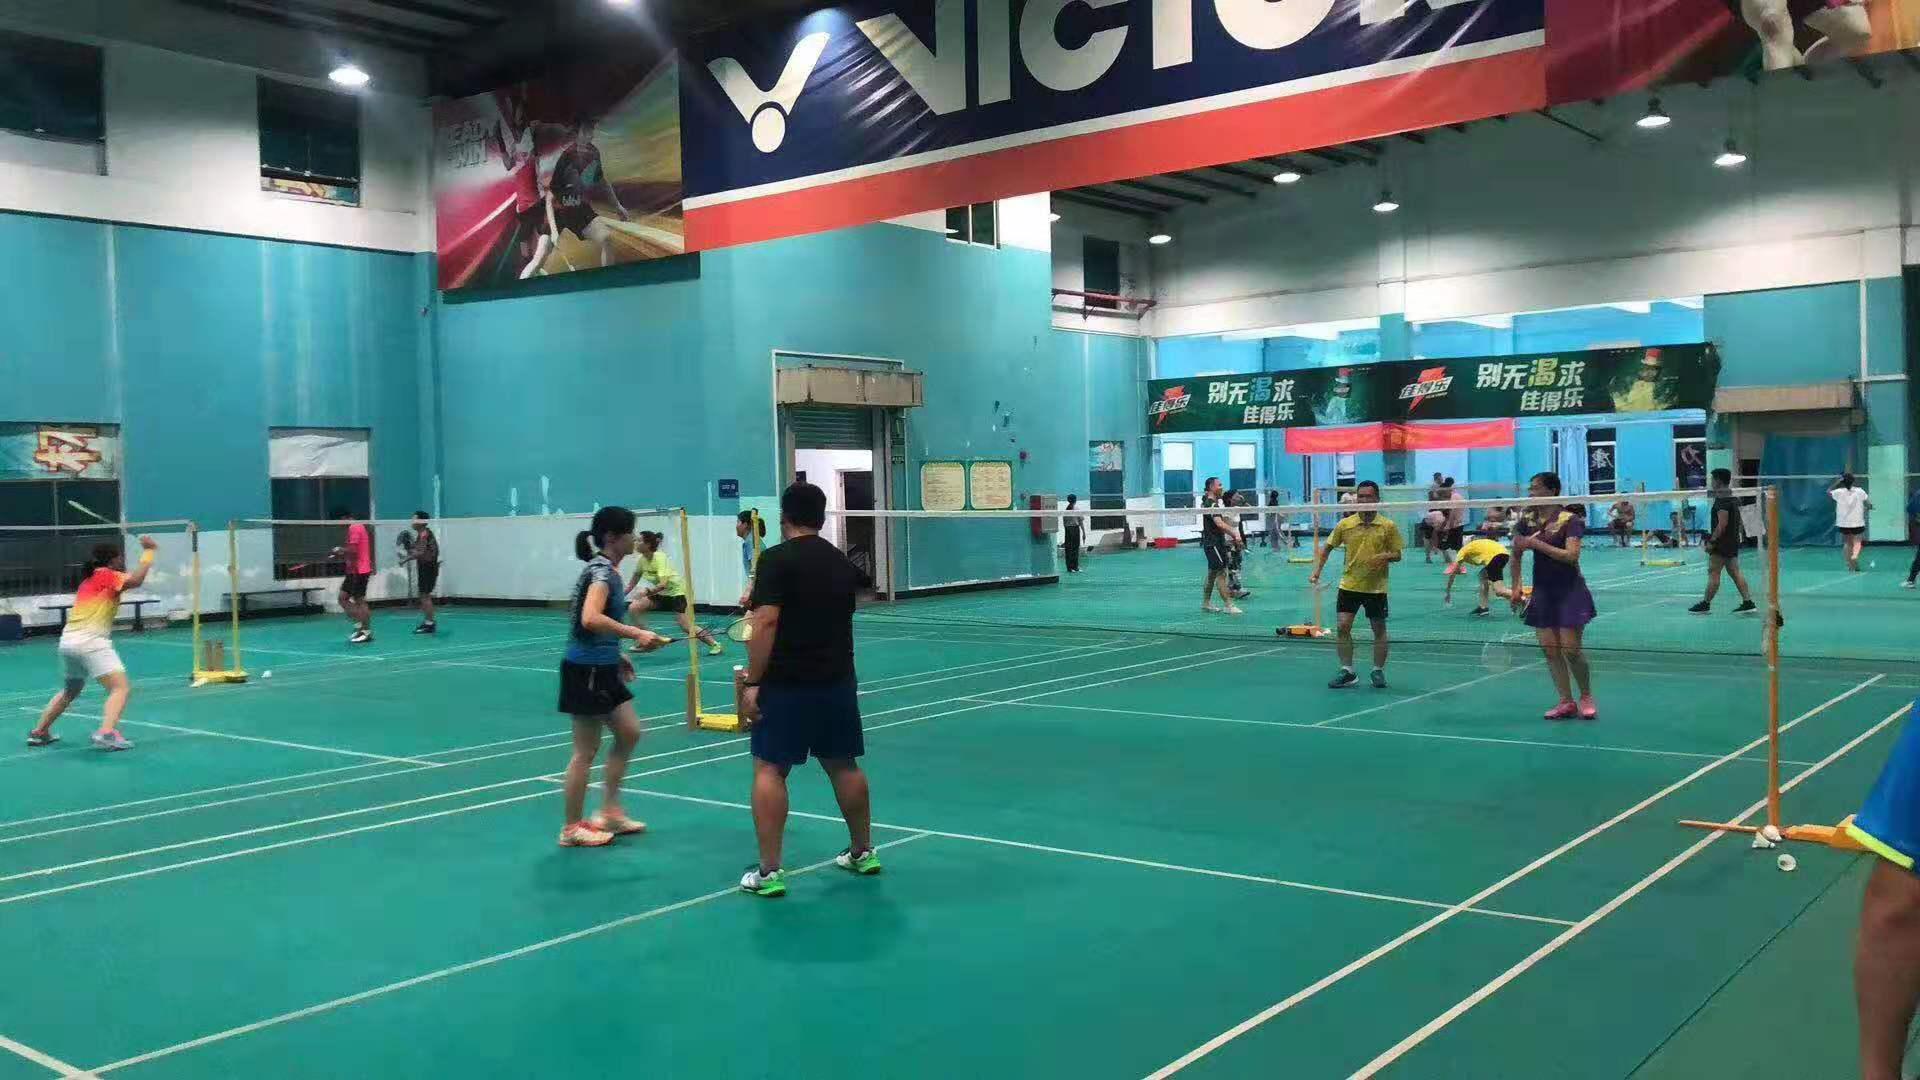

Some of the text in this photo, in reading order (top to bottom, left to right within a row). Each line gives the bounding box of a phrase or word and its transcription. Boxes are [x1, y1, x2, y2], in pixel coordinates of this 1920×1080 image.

[855, 0, 1481, 116] VIC
[1475, 358, 1586, 390] 别无渴求
[1207, 376, 1296, 406] 别无渴求
[1520, 387, 1585, 413] 佳得乐
[1242, 402, 1296, 425] 佳得乐
